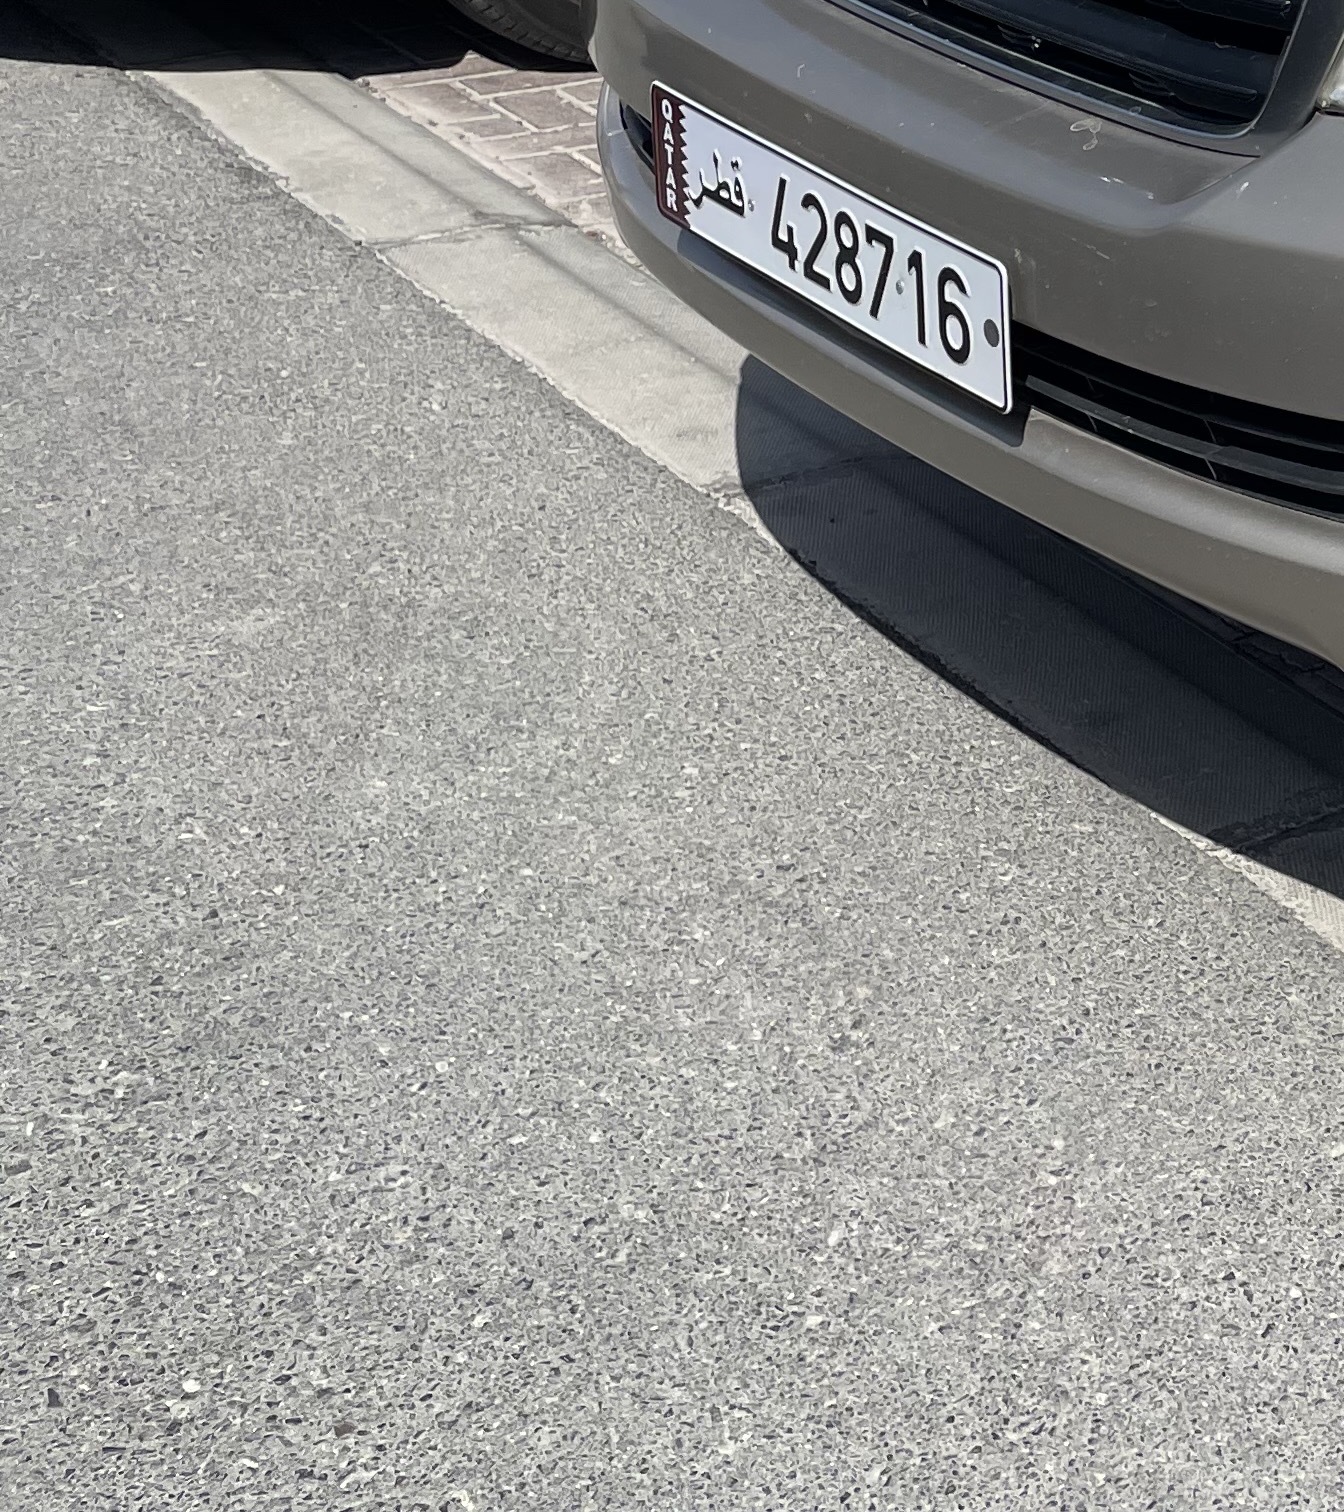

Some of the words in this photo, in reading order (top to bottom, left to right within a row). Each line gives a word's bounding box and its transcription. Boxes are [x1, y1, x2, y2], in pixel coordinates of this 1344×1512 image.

[660, 98, 679, 213] QATAR
[686, 149, 746, 218] قطر
[770, 174, 971, 366] 428716
